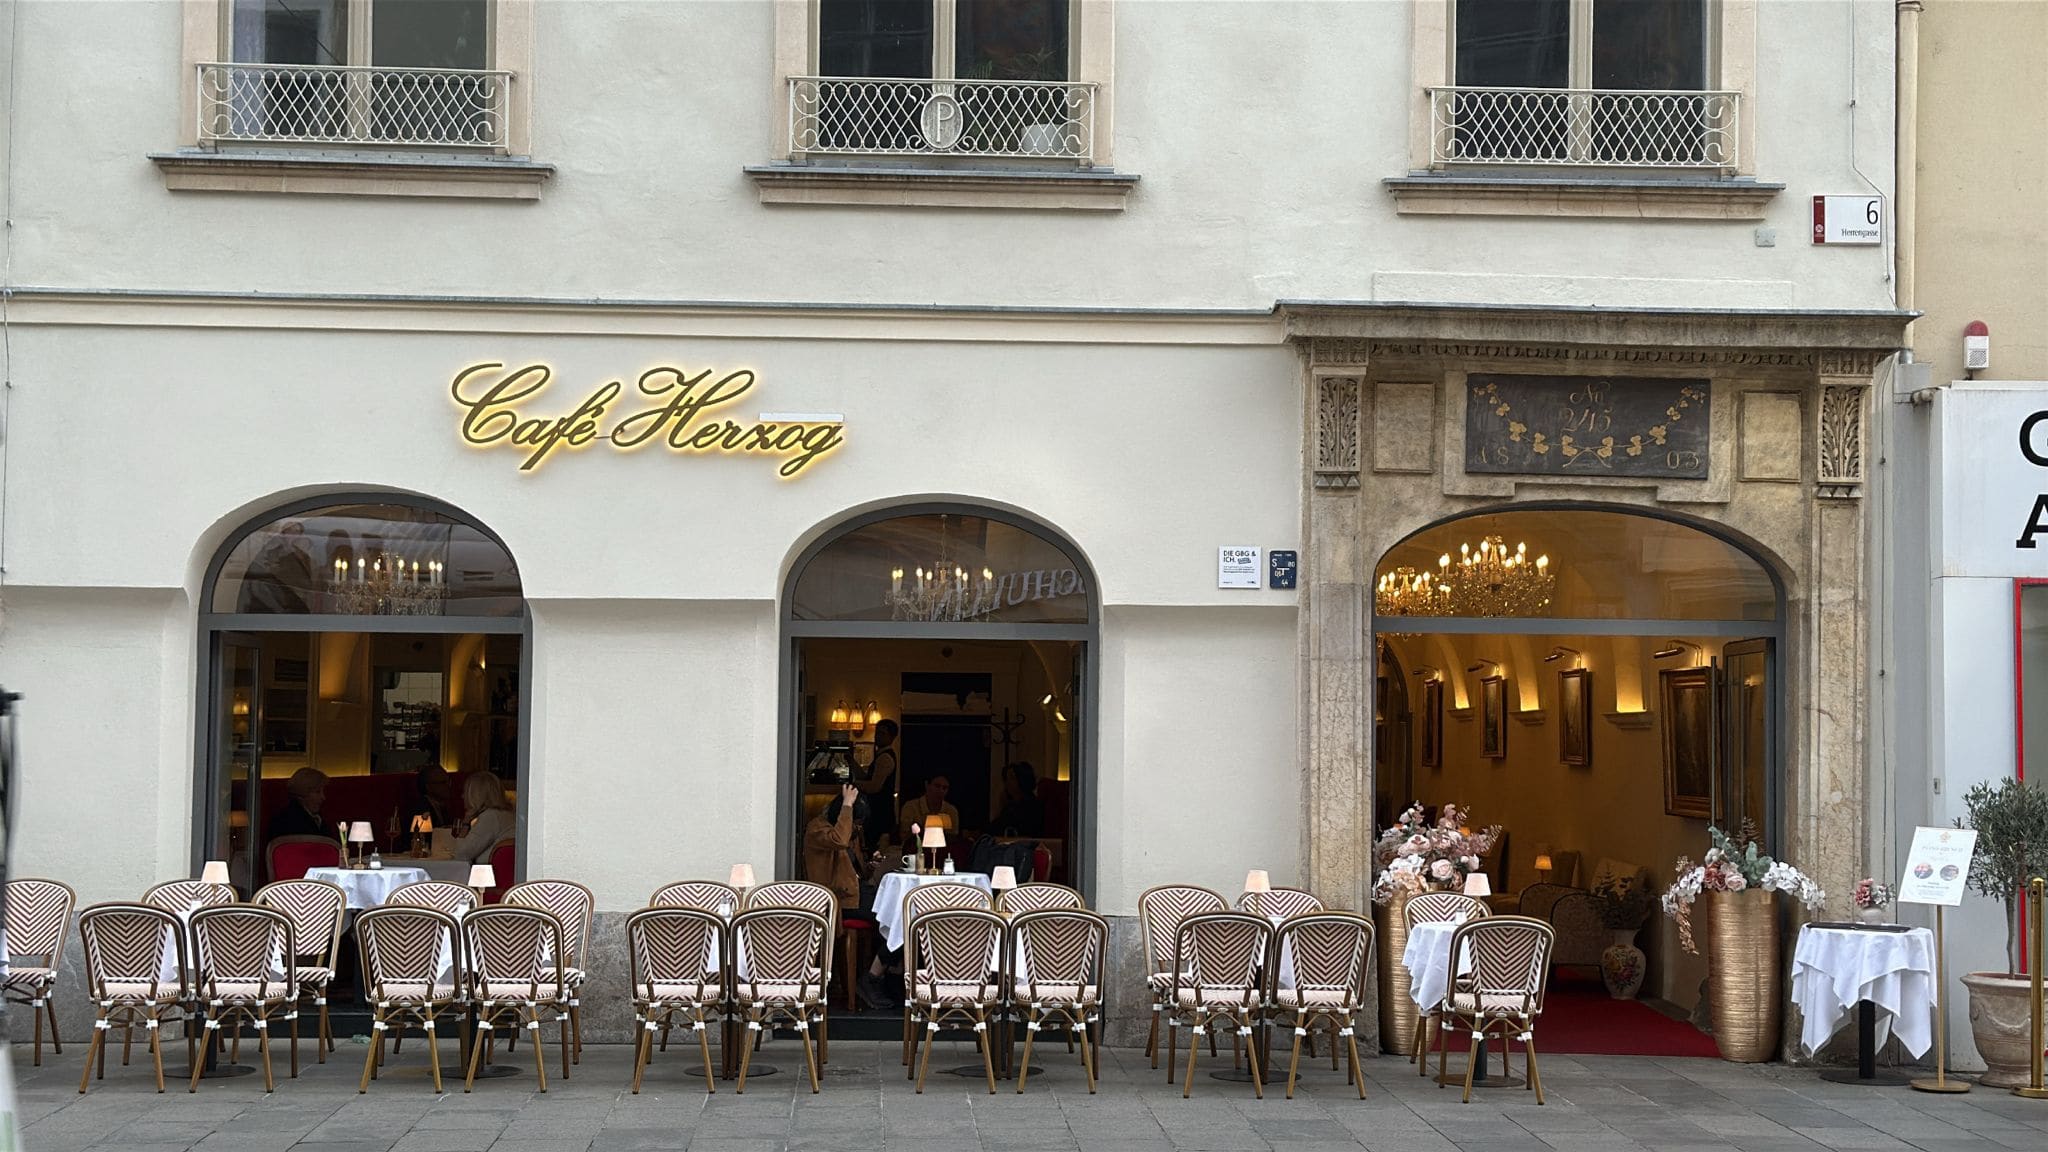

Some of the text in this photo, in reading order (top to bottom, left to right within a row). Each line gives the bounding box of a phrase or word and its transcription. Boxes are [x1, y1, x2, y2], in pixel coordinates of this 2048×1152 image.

[936, 101, 955, 142] P
[1867, 201, 1878, 224] 6
[1841, 229, 1878, 238] Herrengasse
[452, 363, 843, 476] Café Herzog
[1271, 558, 1278, 567] S
